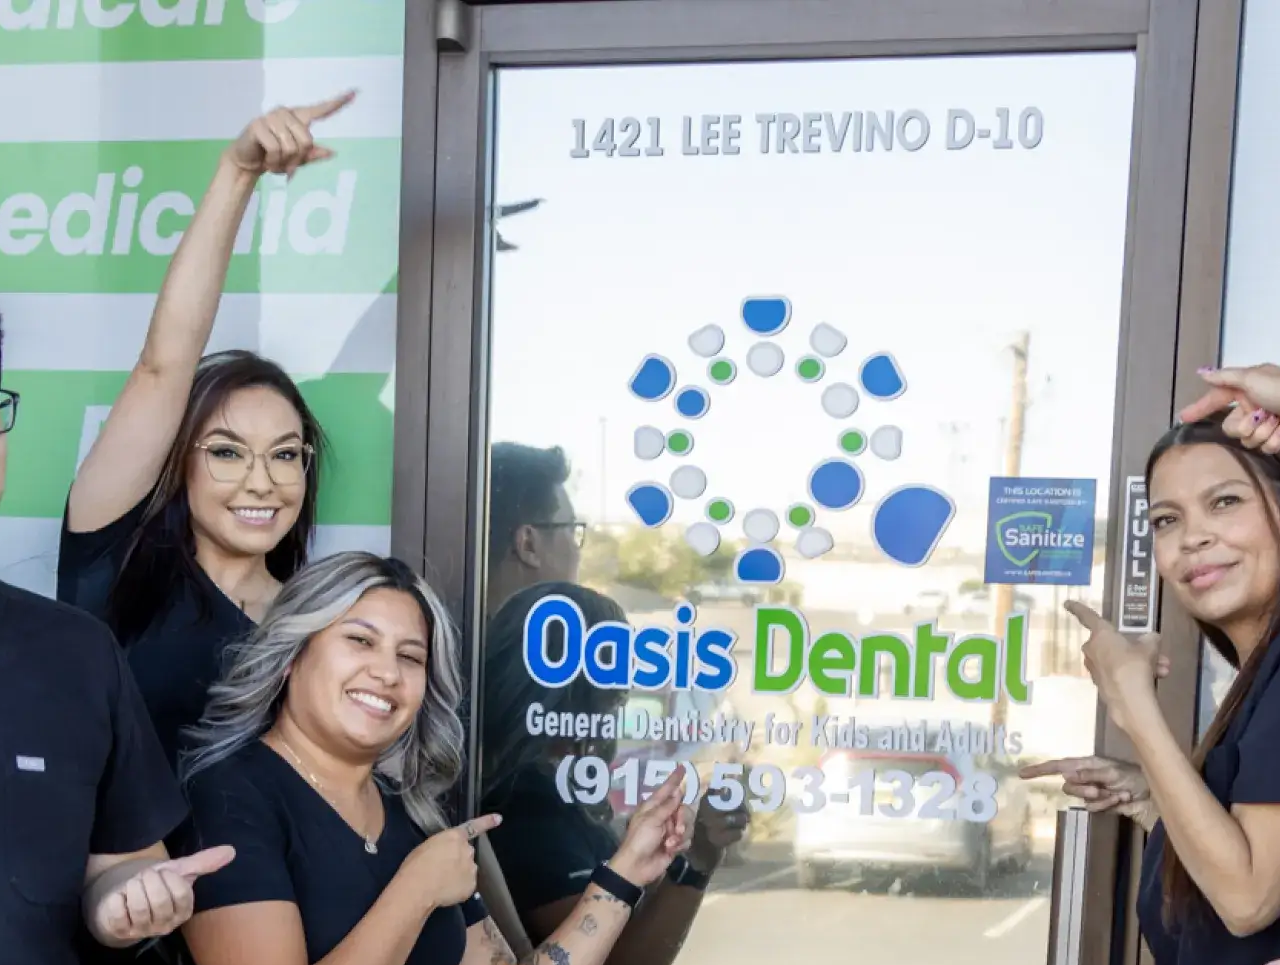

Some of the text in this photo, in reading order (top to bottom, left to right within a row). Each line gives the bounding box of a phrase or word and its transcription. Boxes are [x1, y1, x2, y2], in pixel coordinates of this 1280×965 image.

[569, 106, 1045, 158] 1421 LEE TREVINO D-10
[1005, 527, 1085, 548] Sanitize
[1132, 498, 1149, 578] PULL
[523, 595, 1032, 704] Oasis Dental
[525, 702, 1024, 757] General Dentistry for Kids and Adults
[555, 754, 1000, 824] (915) 593-1328
